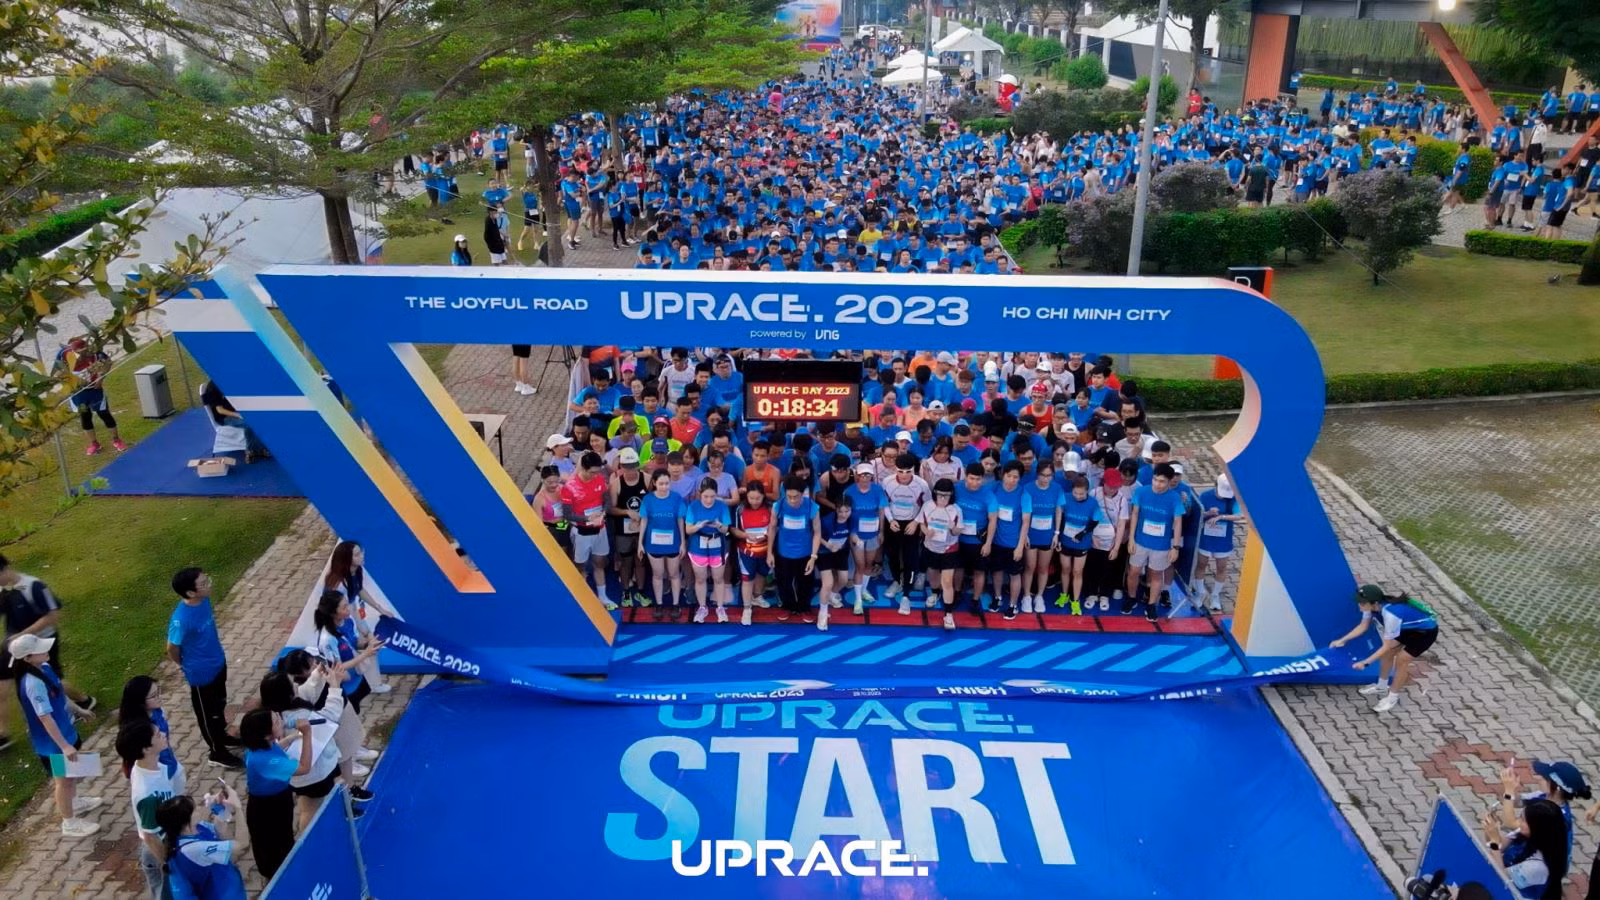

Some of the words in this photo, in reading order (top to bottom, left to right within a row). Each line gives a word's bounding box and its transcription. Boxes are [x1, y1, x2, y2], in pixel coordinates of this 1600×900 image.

[405, 296, 446, 309] THE
[451, 297, 529, 310] JOYFUL
[533, 298, 588, 311] ROAD
[835, 294, 969, 326] 2023
[1002, 306, 1031, 318] HO
[1036, 307, 1068, 319] CHI
[1073, 308, 1121, 320] MINH
[1126, 309, 1171, 321] CITY
[750, 330, 793, 338] powered
[794, 329, 806, 340] by
[802, 386, 823, 394] DAY
[825, 386, 850, 395] 2023
[757, 398, 839, 417] 0:18:34
[603, 735, 1077, 865] START
